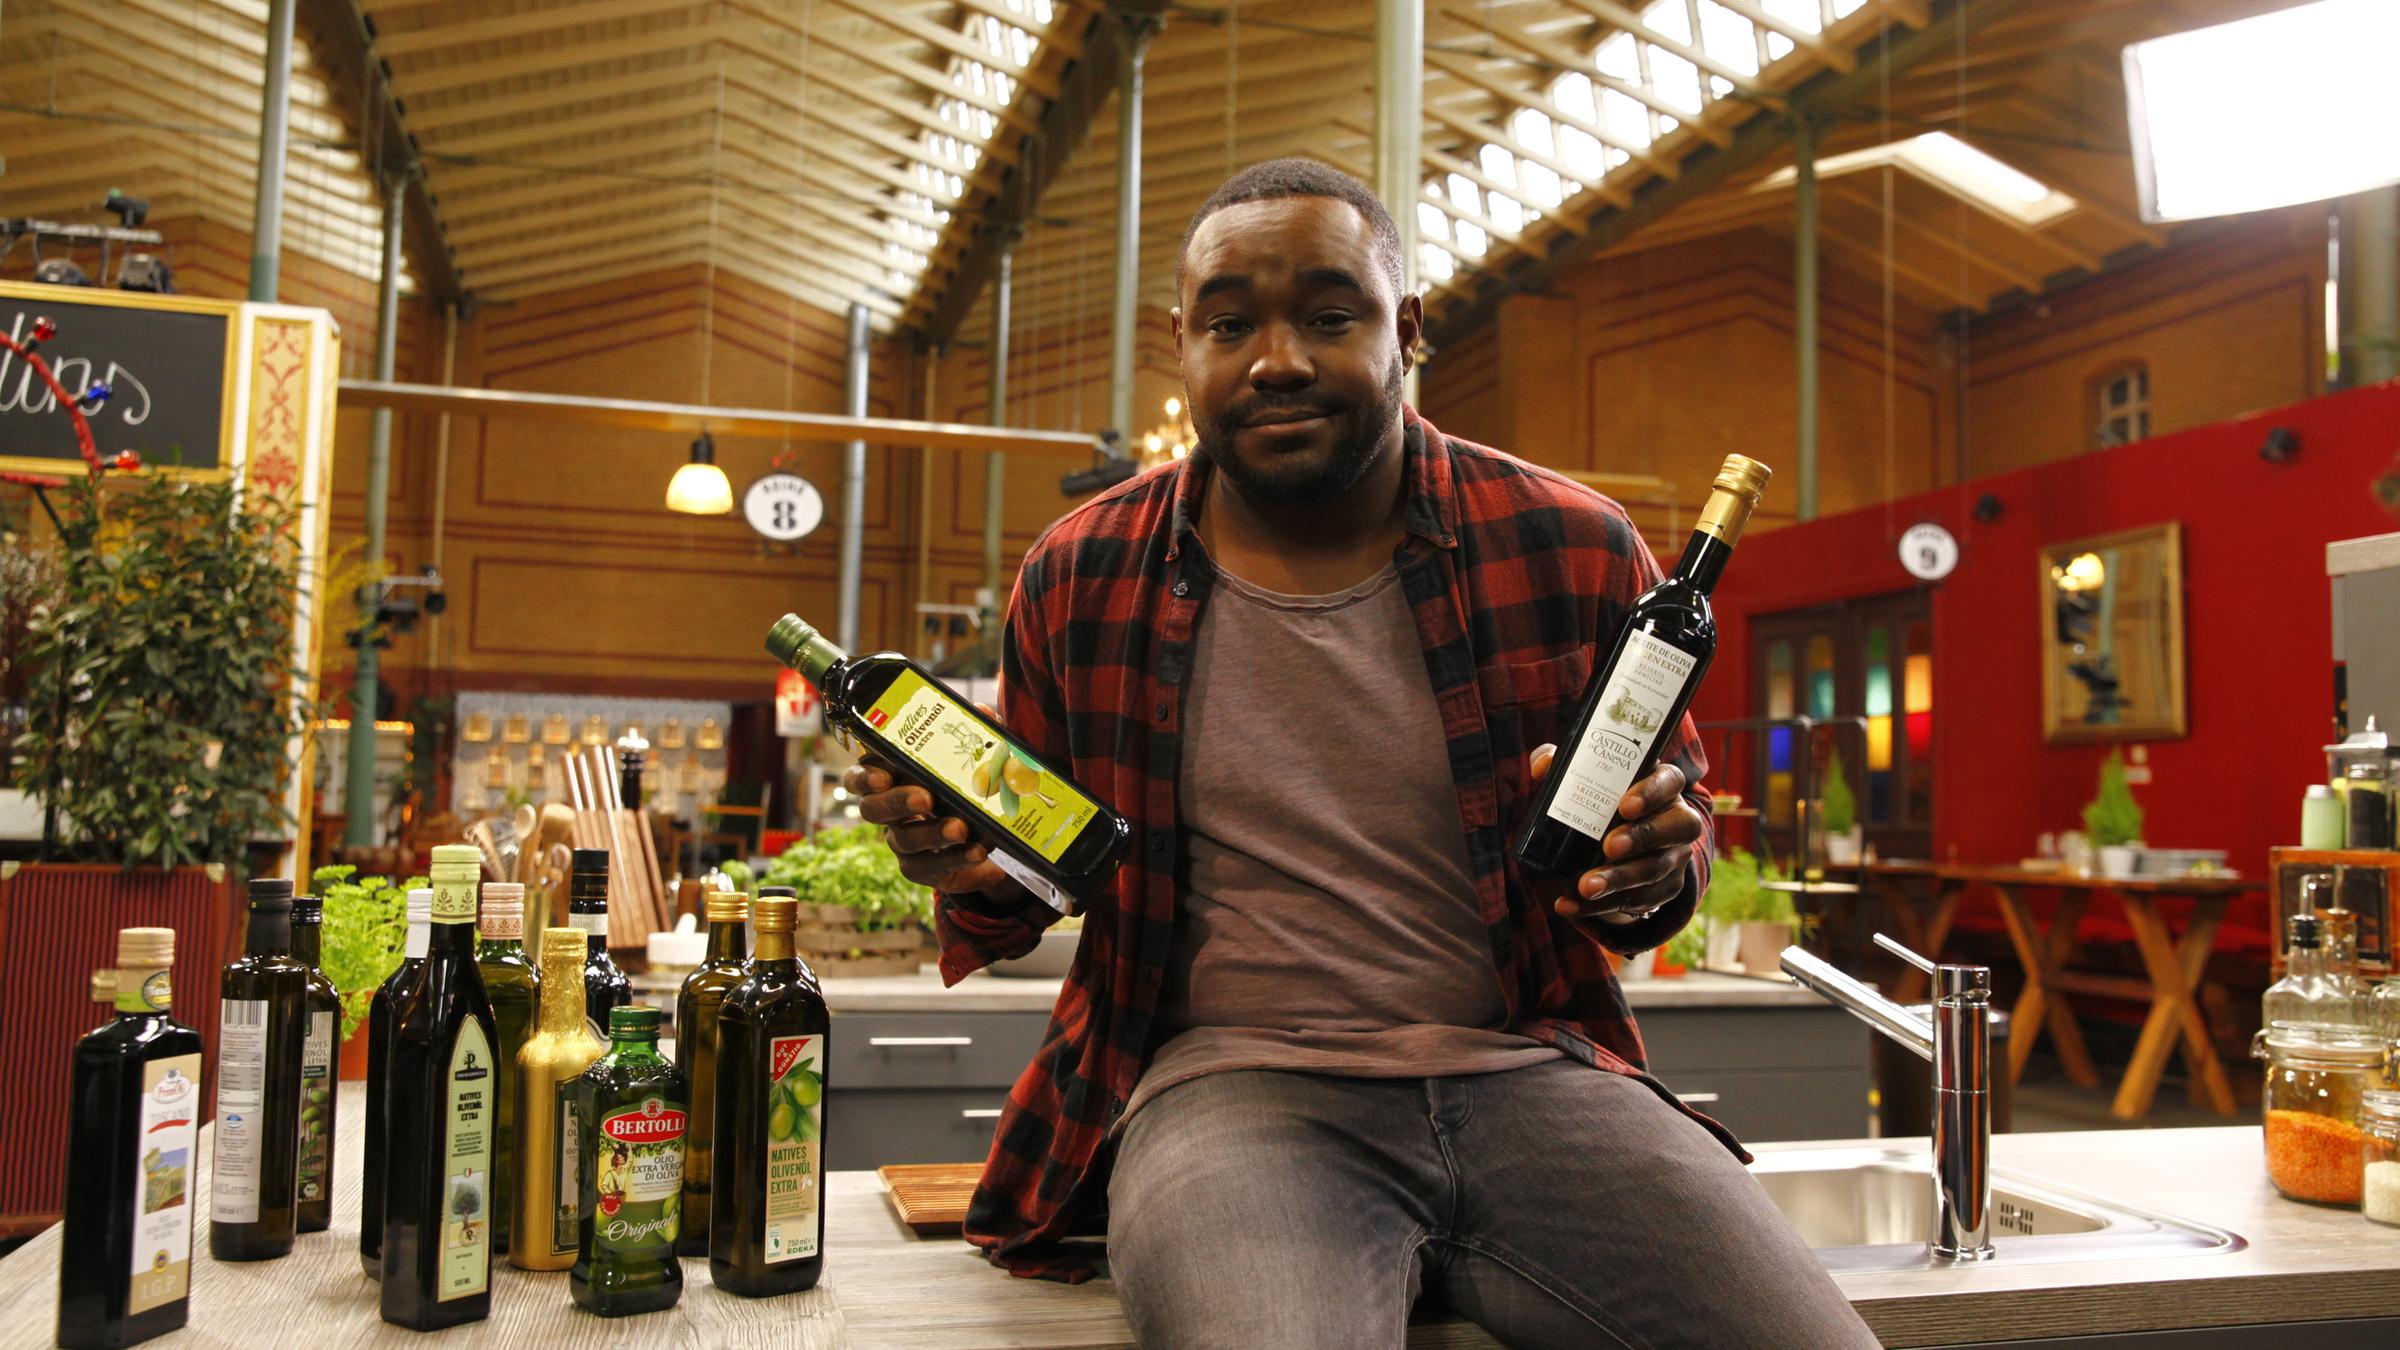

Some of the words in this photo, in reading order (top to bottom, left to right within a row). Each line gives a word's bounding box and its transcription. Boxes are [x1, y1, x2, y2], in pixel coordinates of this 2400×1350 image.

[773, 501, 797, 529] 8
[1920, 547, 1938, 571] 9
[1659, 648, 1670, 657] DE
[1670, 653, 1691, 669] OLIVA
[1661, 661, 1686, 678] EXTRA
[898, 703, 928, 740] natives
[905, 702, 946, 747] Olivenöl
[914, 731, 935, 752] extra
[1591, 730, 1638, 761] CASTILLO
[1571, 793, 1601, 812] PICUAL
[1071, 815, 1085, 829] 750
[1083, 806, 1092, 817] ml
[1572, 814, 1584, 825] 500
[776, 1043, 788, 1058] GUT
[459, 1091, 482, 1102] NATIVES
[461, 1112, 478, 1121] EXTRA
[613, 1117, 685, 1136] BERTOLLI
[654, 1155, 674, 1164] OLIO
[771, 1146, 807, 1162] NATIVES
[632, 1165, 657, 1174] EXTRA
[645, 1173, 654, 1181] DI
[656, 1171, 680, 1180] OLIVA
[771, 1159, 811, 1179] OLIVENÖL
[770, 1179, 797, 1195] EXTRA
[787, 1239, 799, 1248] 750
[787, 1245, 814, 1255] EDEKA
